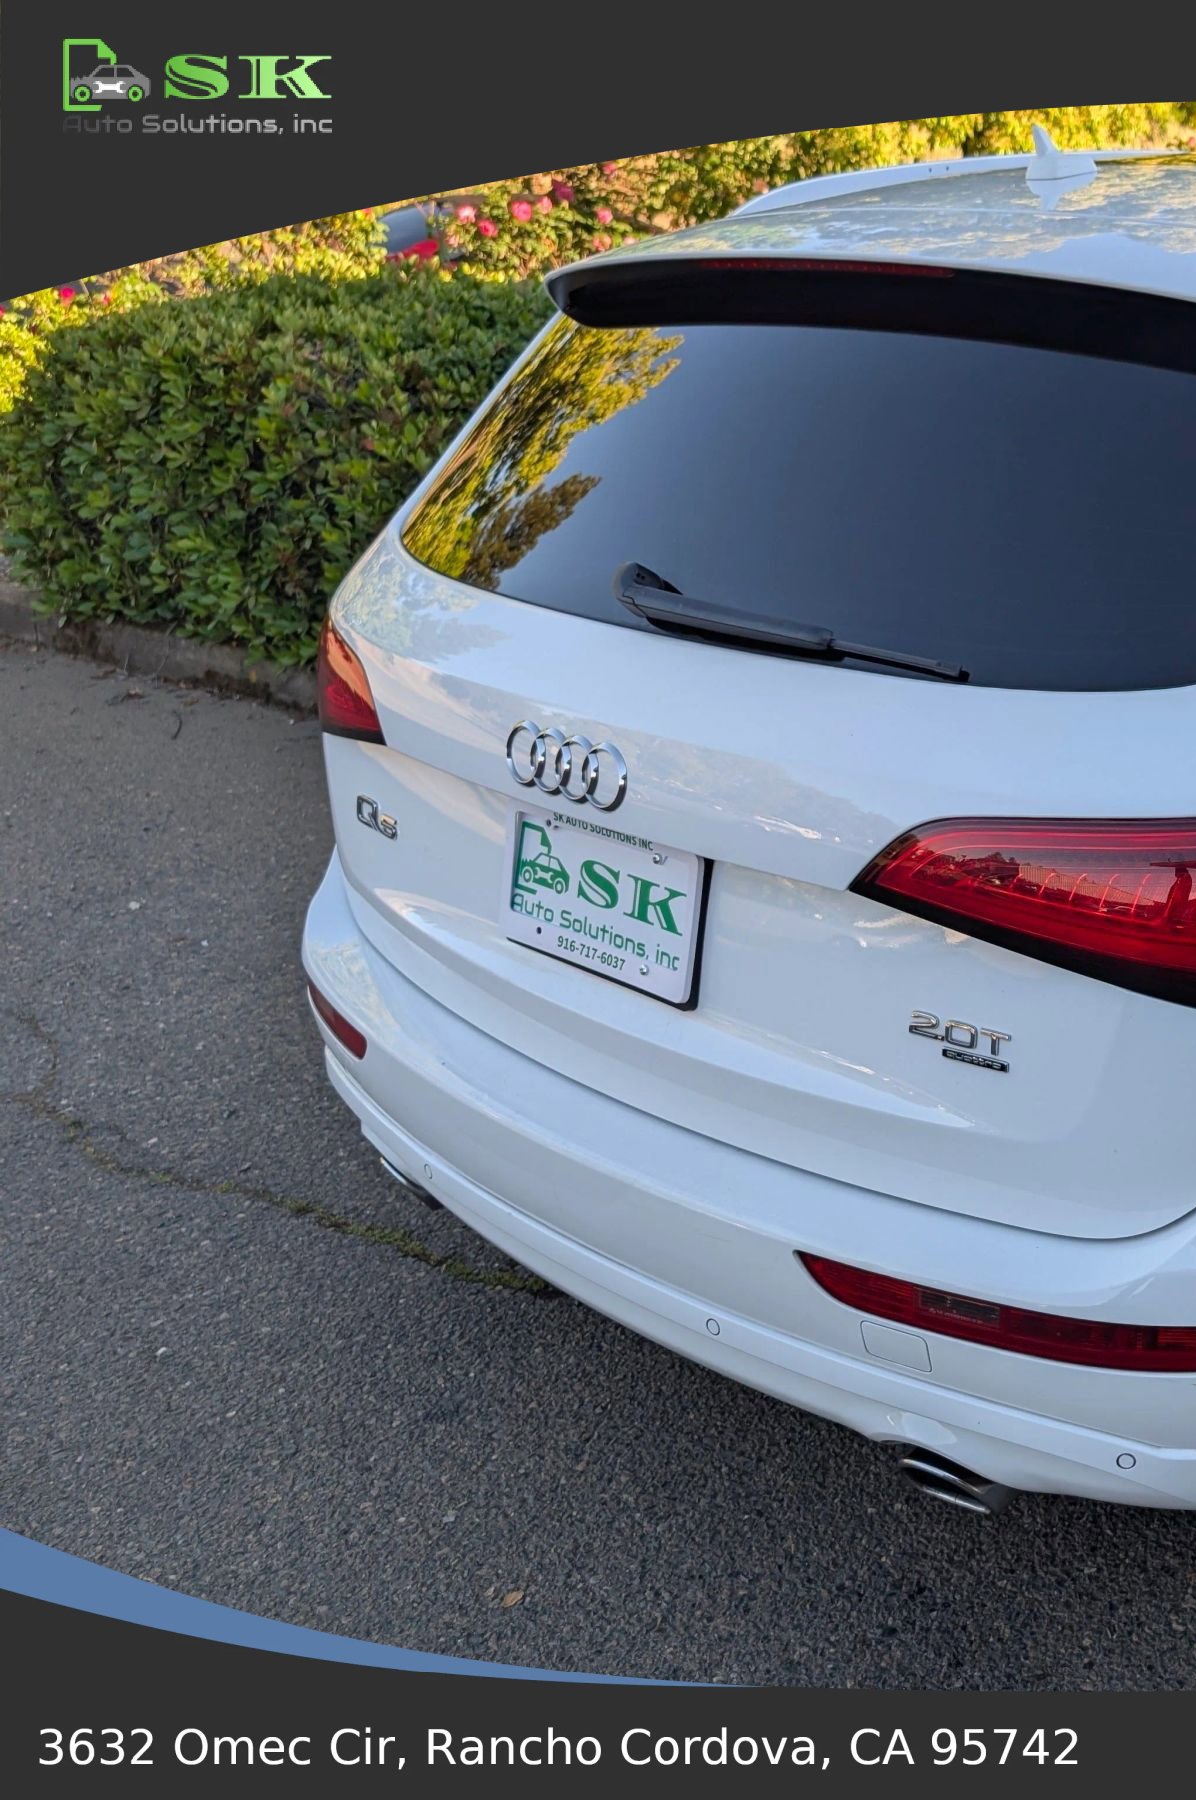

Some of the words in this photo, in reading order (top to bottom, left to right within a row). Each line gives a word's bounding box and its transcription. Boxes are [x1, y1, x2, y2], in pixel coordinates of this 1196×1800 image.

[356, 795, 398, 840] Q5
[553, 811, 565, 823] SK
[565, 814, 588, 831] AUTO
[638, 837, 654, 851] INC
[577, 859, 687, 937] SK
[512, 893, 555, 923] Auto
[559, 909, 650, 960] Solutions,
[655, 943, 680, 972] inc
[557, 935, 626, 972] 916-717-6037
